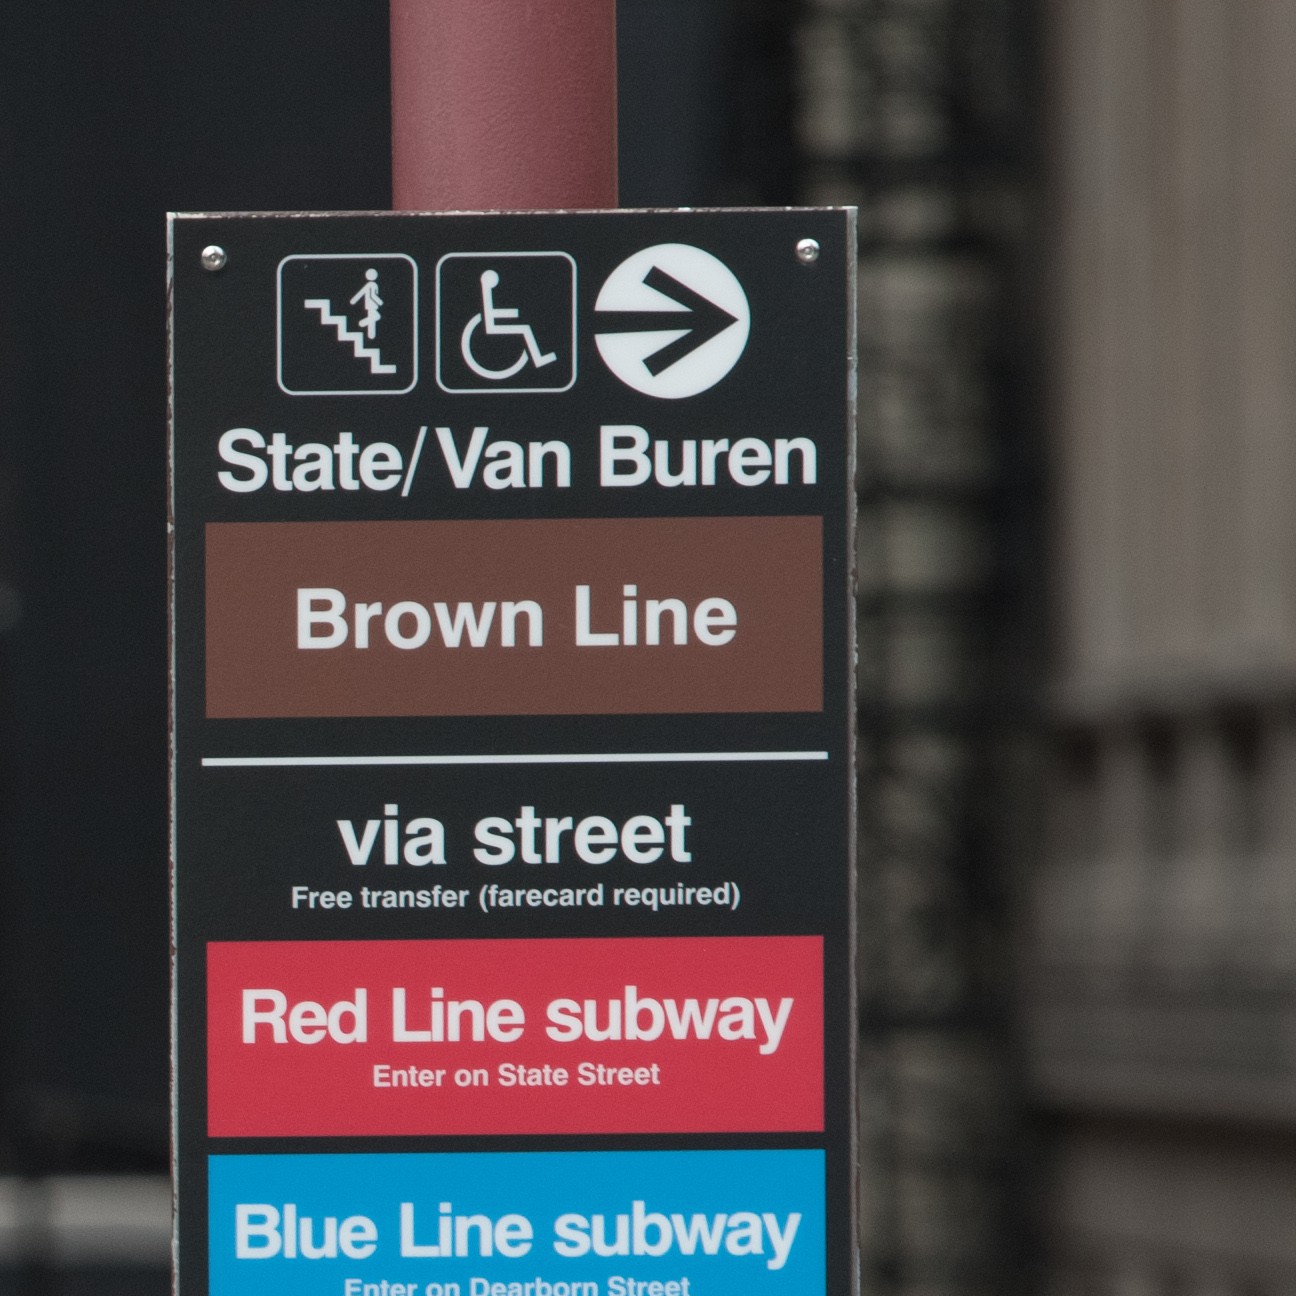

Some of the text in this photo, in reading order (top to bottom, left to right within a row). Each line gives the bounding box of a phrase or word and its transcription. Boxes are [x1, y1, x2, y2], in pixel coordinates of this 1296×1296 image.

[600, 424, 817, 488] Buren
[297, 584, 738, 650] Brown Line
[336, 803, 692, 867] via street
[291, 881, 741, 913] Free transfer (farecard required)
[242, 985, 794, 1055] Red Line subway
[373, 1061, 661, 1088] Enter on State Street
[235, 1199, 802, 1271] Blue Line subway
